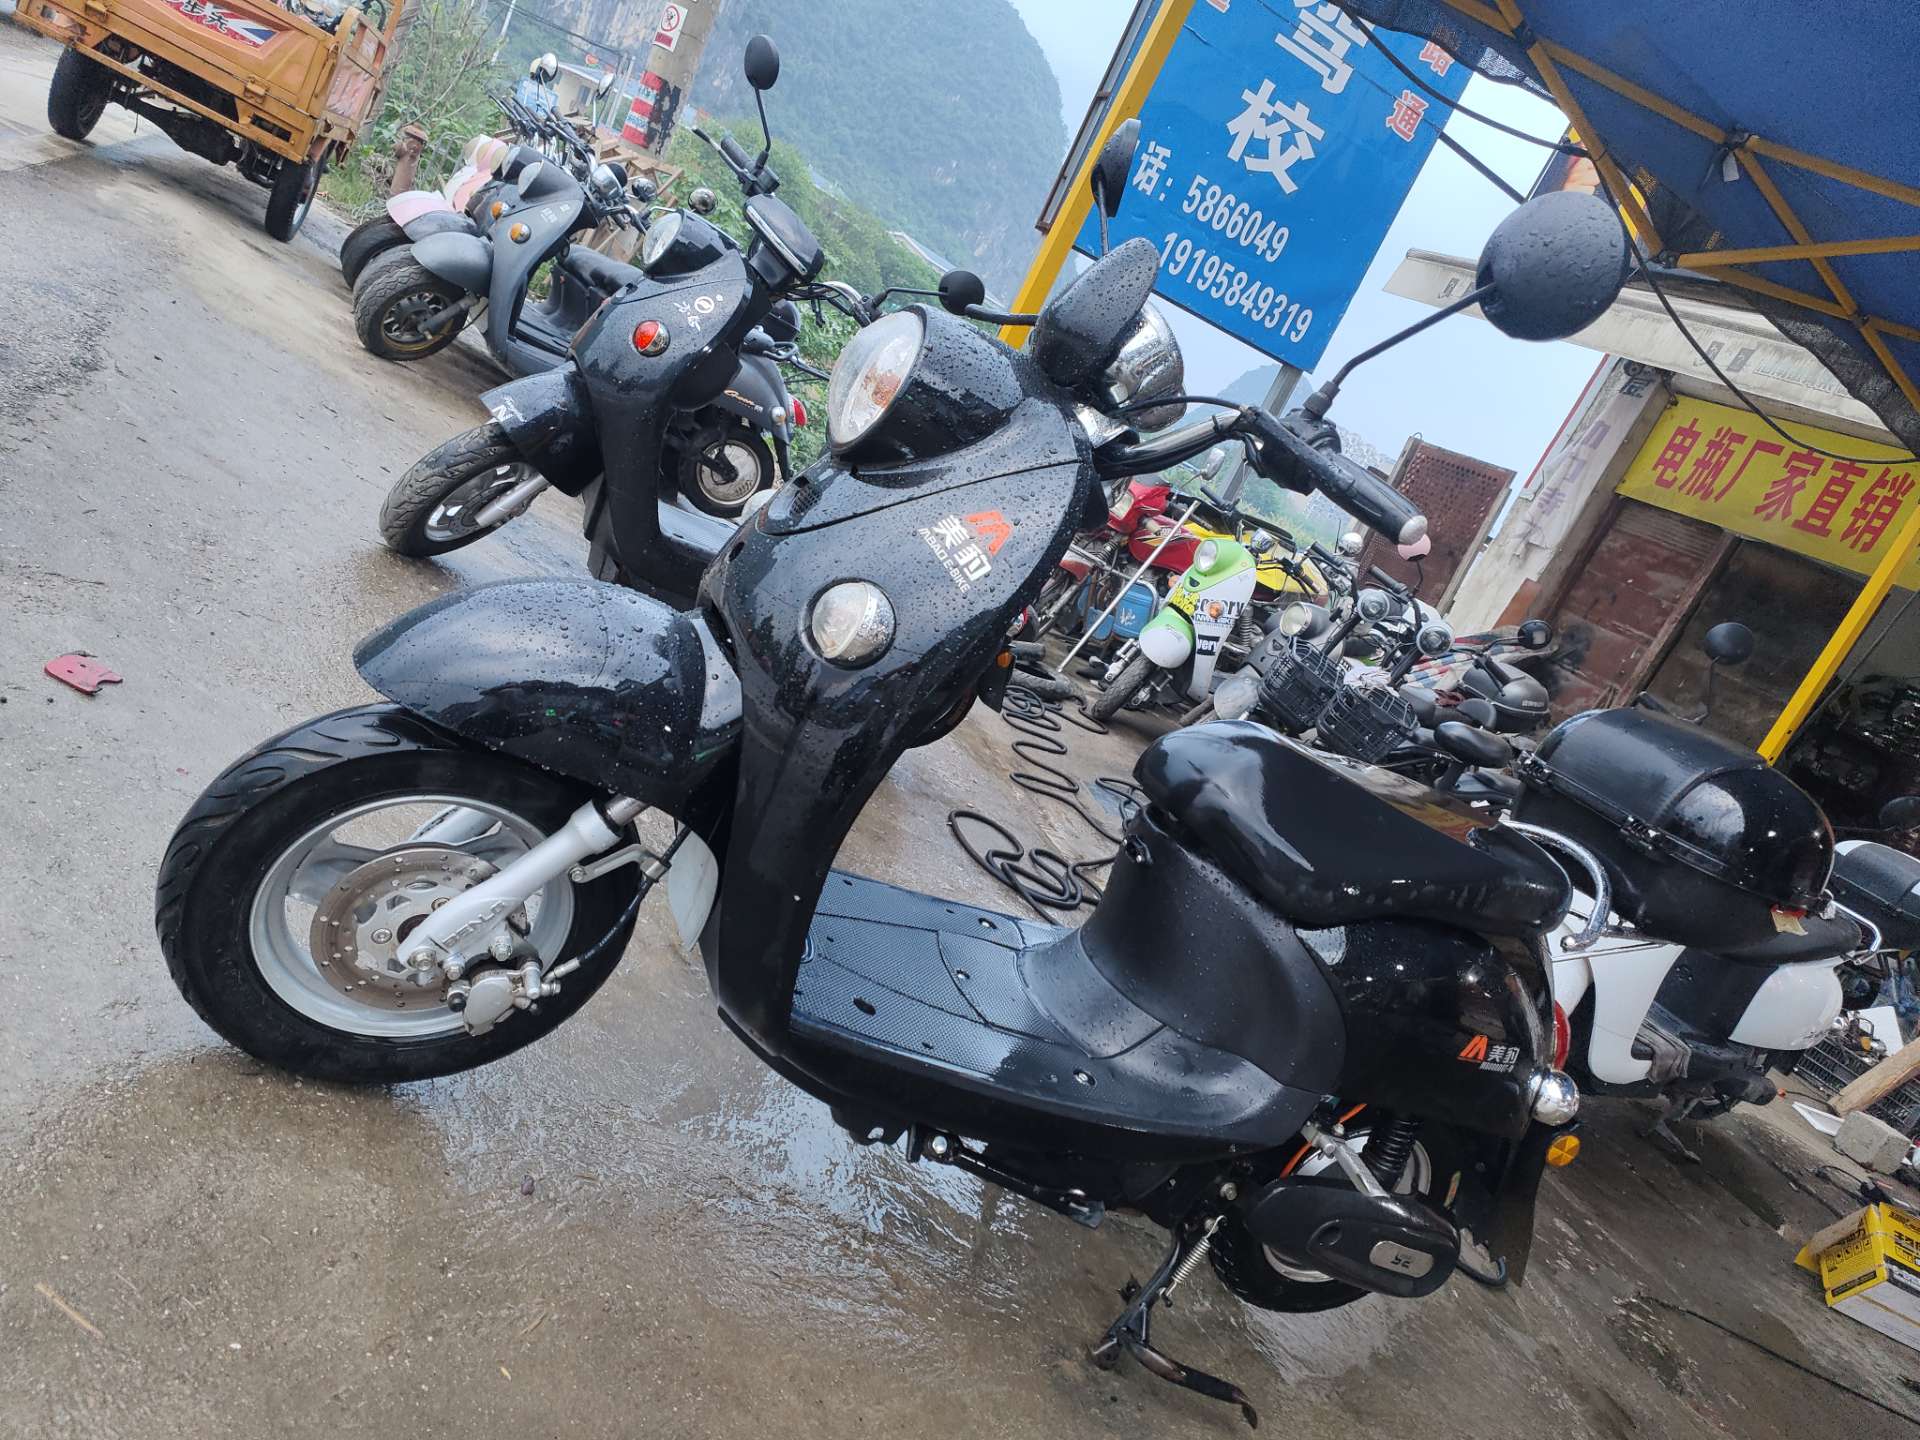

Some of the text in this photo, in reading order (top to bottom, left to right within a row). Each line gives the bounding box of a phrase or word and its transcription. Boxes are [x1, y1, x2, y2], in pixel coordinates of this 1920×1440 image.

[1159, 231, 1314, 344] 19195849319
[1651, 416, 1916, 553] 电瓶厂家直销
[931, 514, 992, 582] 美豹
[1487, 1045, 1520, 1064] 美豹
